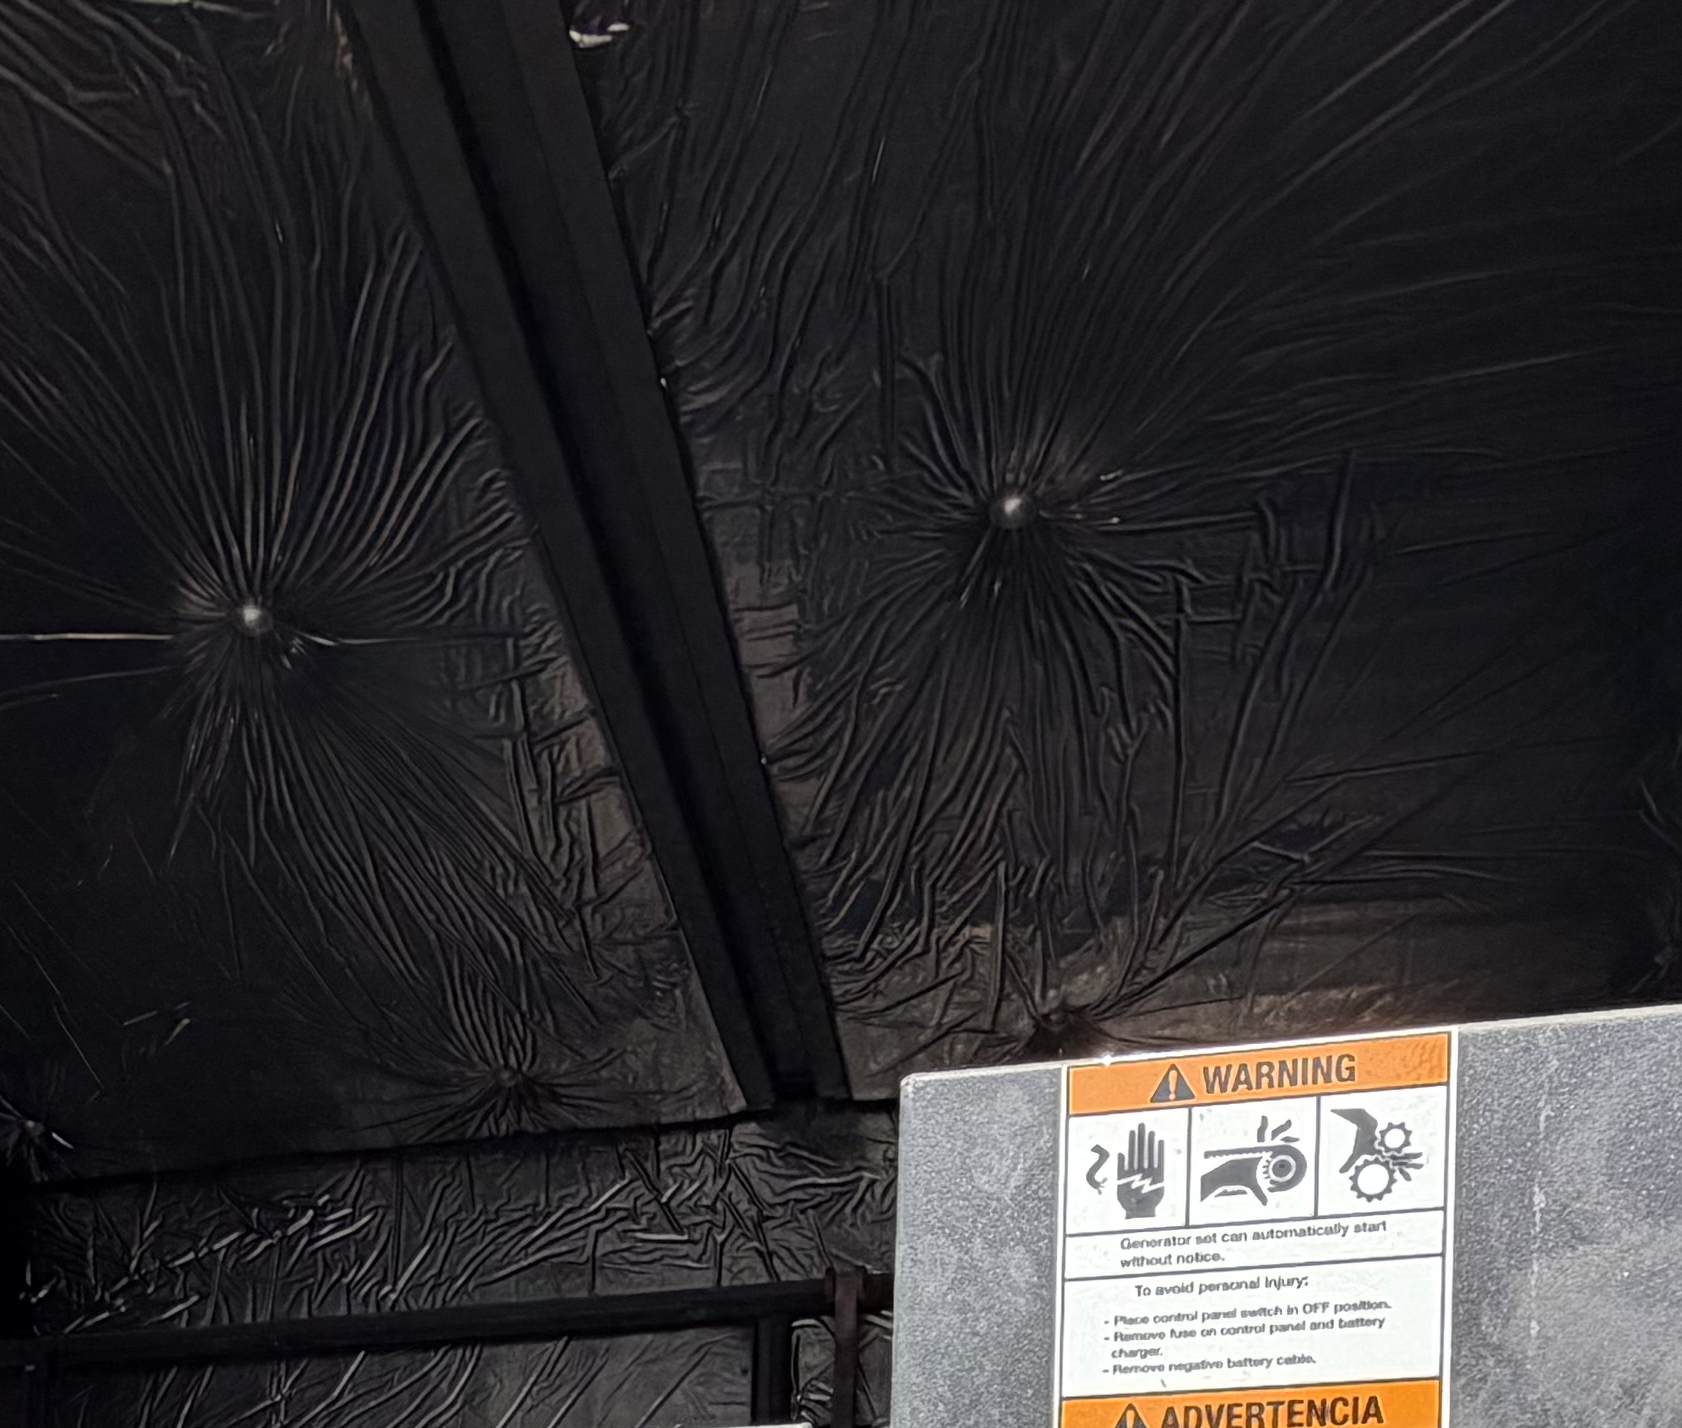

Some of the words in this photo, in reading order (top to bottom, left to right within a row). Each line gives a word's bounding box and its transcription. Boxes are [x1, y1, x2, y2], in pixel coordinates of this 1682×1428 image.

[1203, 1053, 1356, 1094] WARNING
[1121, 1235, 1191, 1251] Generator
[1196, 1233, 1217, 1246] set
[1221, 1231, 1247, 1243] can
[1252, 1224, 1349, 1241] automatically
[1353, 1221, 1386, 1234] start
[1121, 1254, 1172, 1269] without
[1176, 1251, 1225, 1266] notice.
[1136, 1284, 1151, 1297] To
[1156, 1281, 1194, 1296] avoid
[1198, 1277, 1260, 1296] personal
[1115, 1315, 1149, 1326] Place
[1153, 1310, 1198, 1324] control
[1202, 1308, 1236, 1323] panel
[1241, 1305, 1283, 1319] switch
[1287, 1303, 1299, 1315] in
[1303, 1302, 1330, 1314] OFF
[1334, 1300, 1391, 1314] position.
